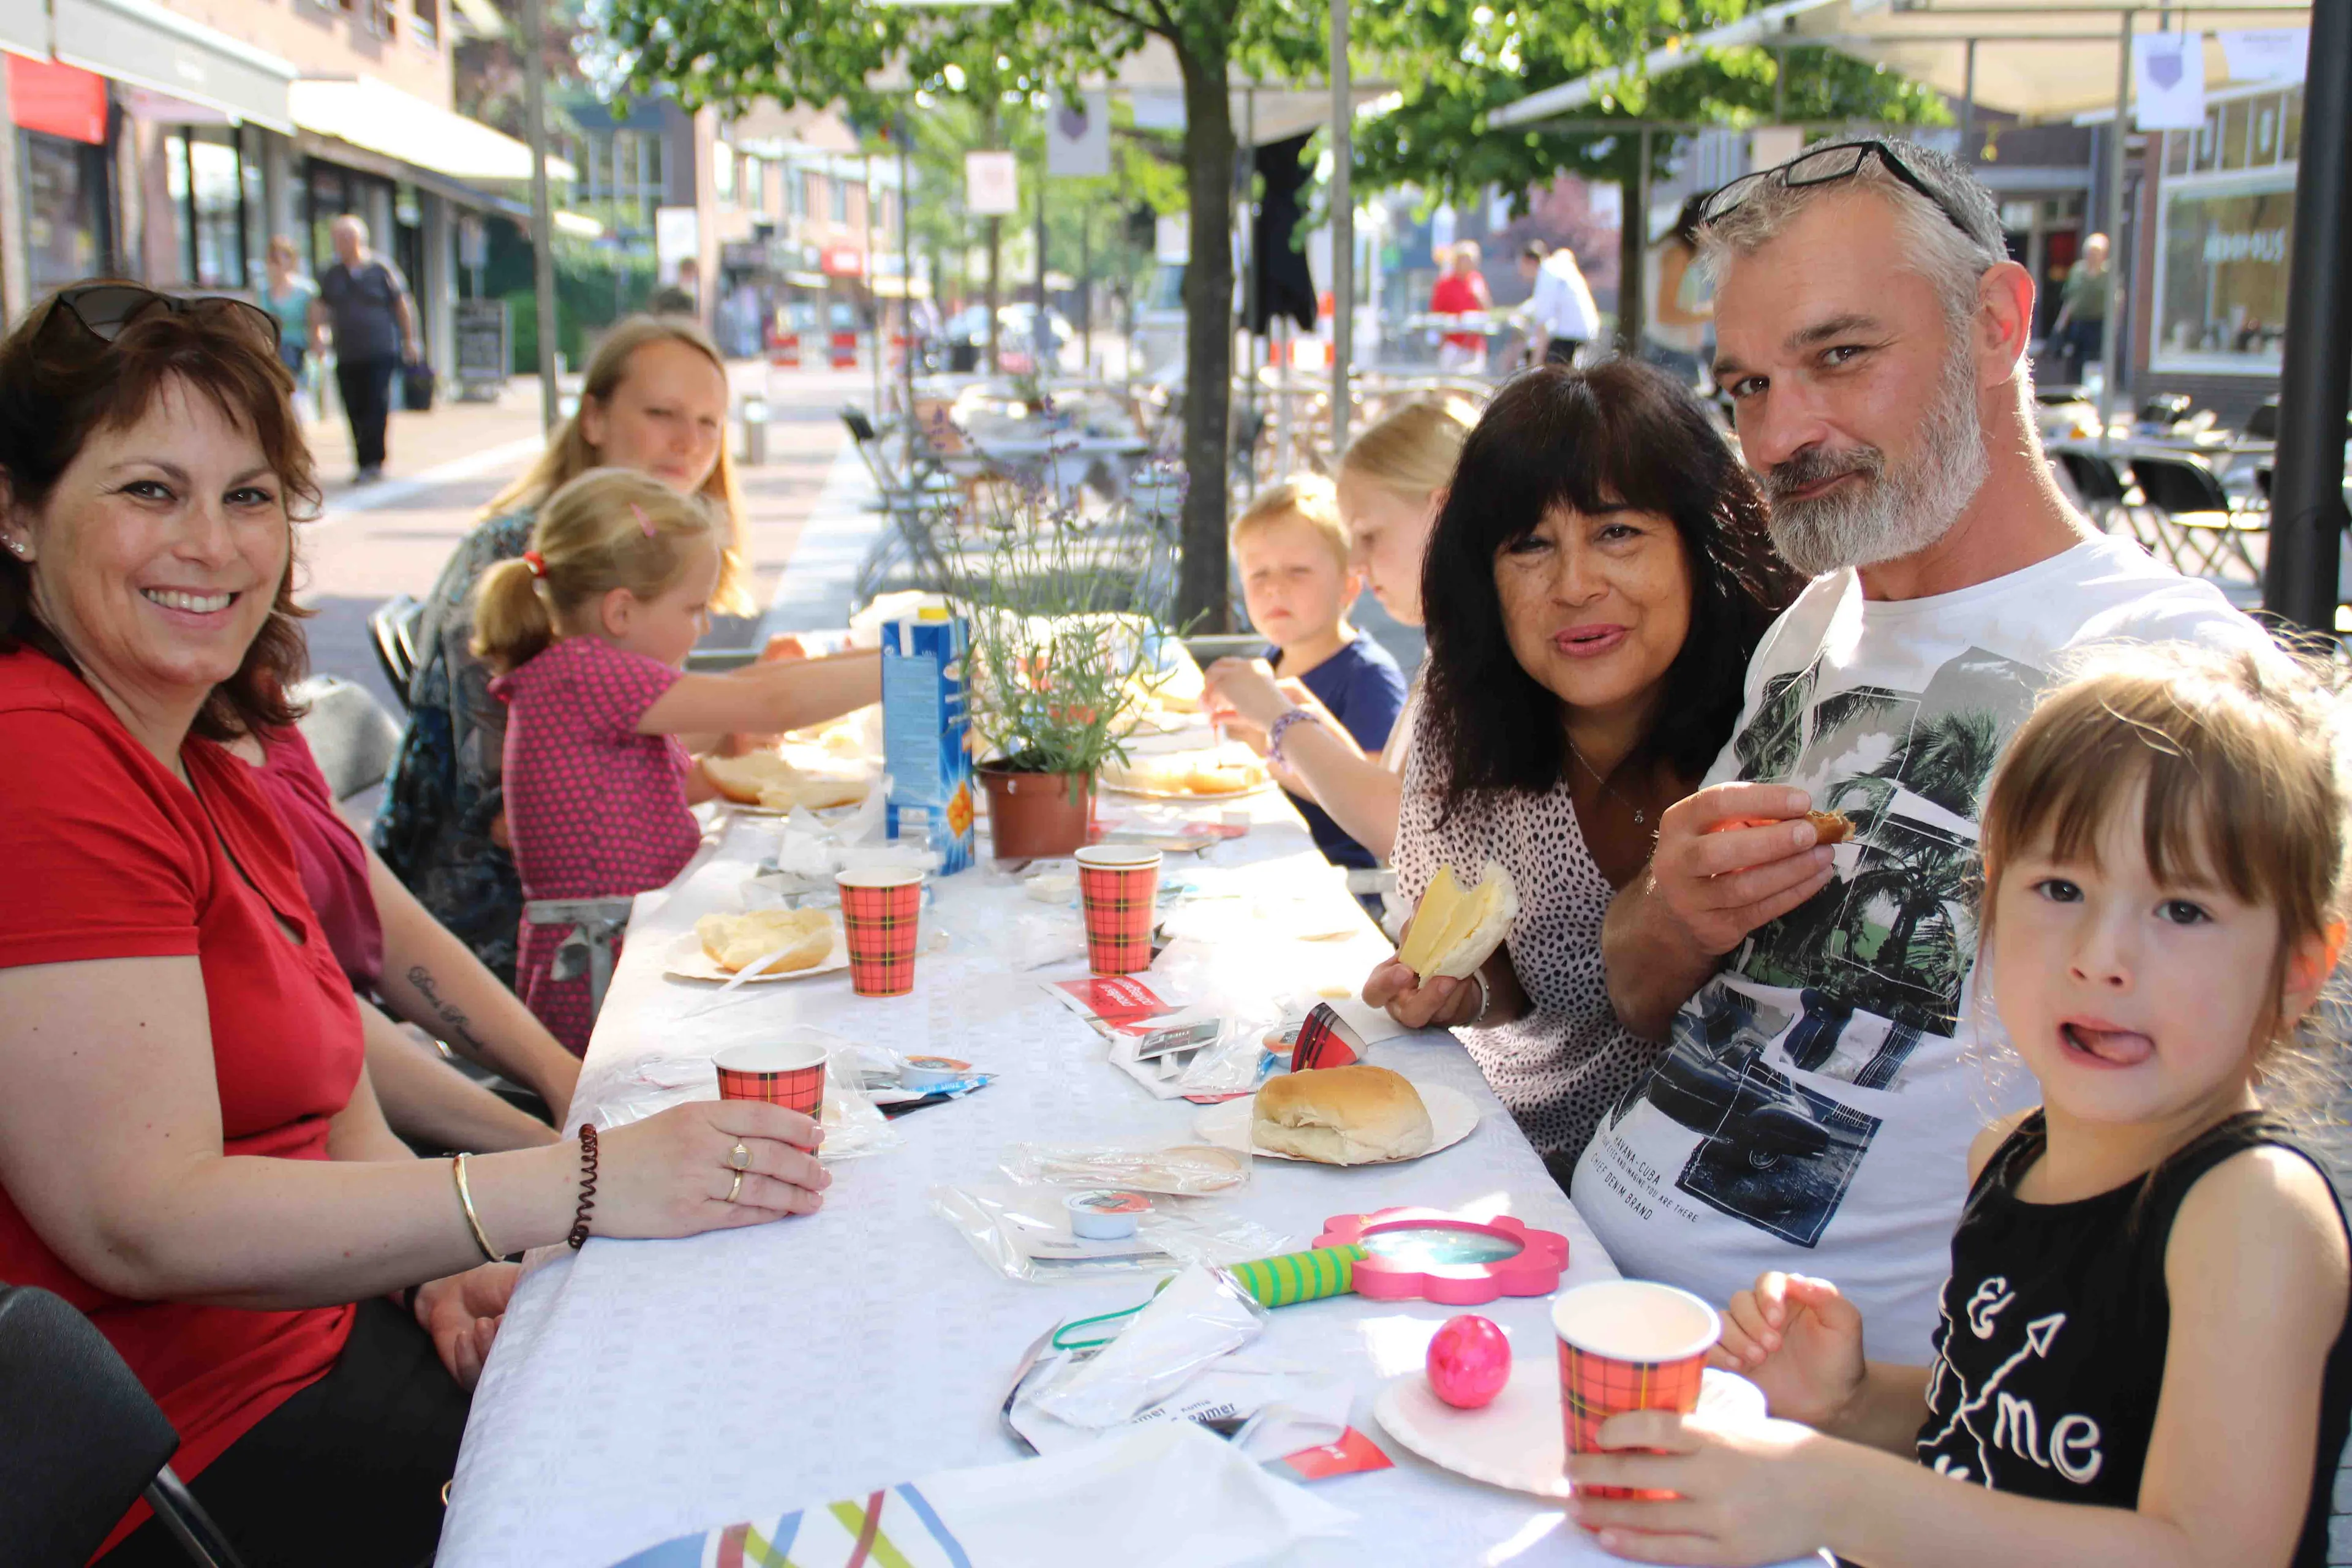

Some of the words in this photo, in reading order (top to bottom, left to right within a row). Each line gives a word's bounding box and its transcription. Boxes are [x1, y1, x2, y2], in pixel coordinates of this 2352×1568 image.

[1591, 1152, 1608, 1175] CHIEF
[1604, 1172, 1627, 1198] DENIM
[1624, 1193, 1653, 1221] BRAND
[1617, 1156, 1627, 1170] AND
[1626, 1165, 1646, 1188] IMAGINE
[1646, 1184, 1659, 1198] YOU
[1658, 1195, 1673, 1208] ARE
[1674, 1204, 1698, 1223] THERE
[1992, 1391, 2103, 1485] me
